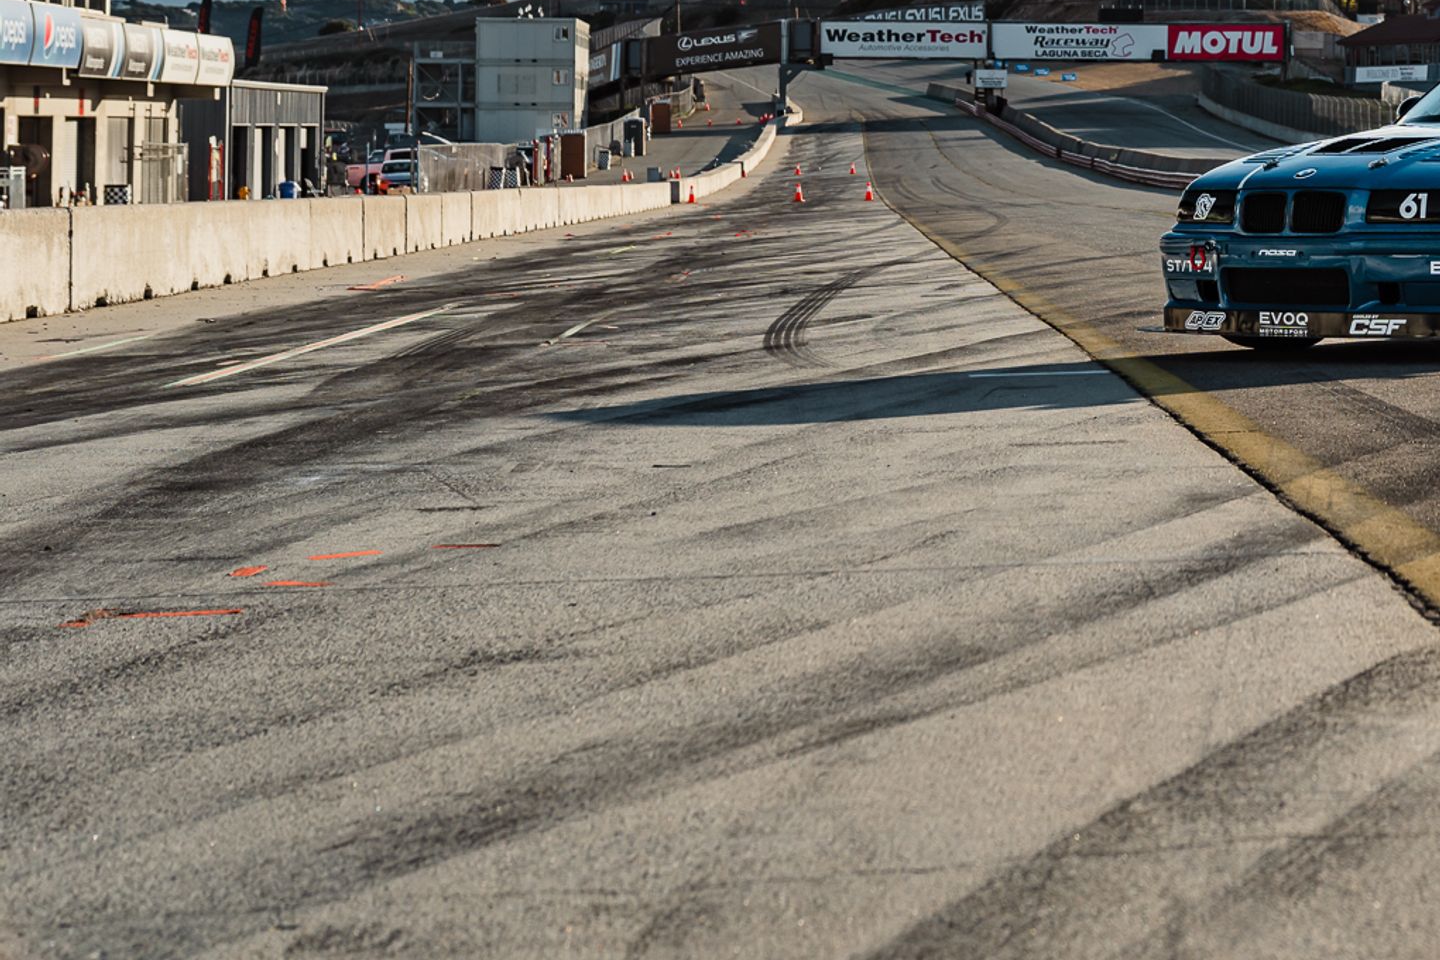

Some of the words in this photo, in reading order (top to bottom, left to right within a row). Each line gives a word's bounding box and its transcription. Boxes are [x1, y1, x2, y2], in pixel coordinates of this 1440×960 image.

[2, 16, 26, 50] pepsi
[825, 28, 984, 44] WeatherTech
[1025, 25, 1117, 35] WeatherTech
[53, 22, 76, 55] pepsi
[693, 33, 736, 47] LEXUS
[1033, 35, 1111, 49] Raceway
[1173, 30, 1278, 55] MOTUL
[858, 43, 901, 52] Automotive
[903, 43, 950, 52] Accessories
[1035, 49, 1079, 58] LAGUNA
[1081, 49, 1108, 58] SECA
[676, 53, 723, 67] EXPERIENCE
[725, 48, 764, 61] AMAZING
[1399, 193, 1428, 219] 61
[1187, 312, 1224, 327] APEX
[1259, 311, 1308, 325] EVOQ
[1349, 319, 1407, 336] CSF
